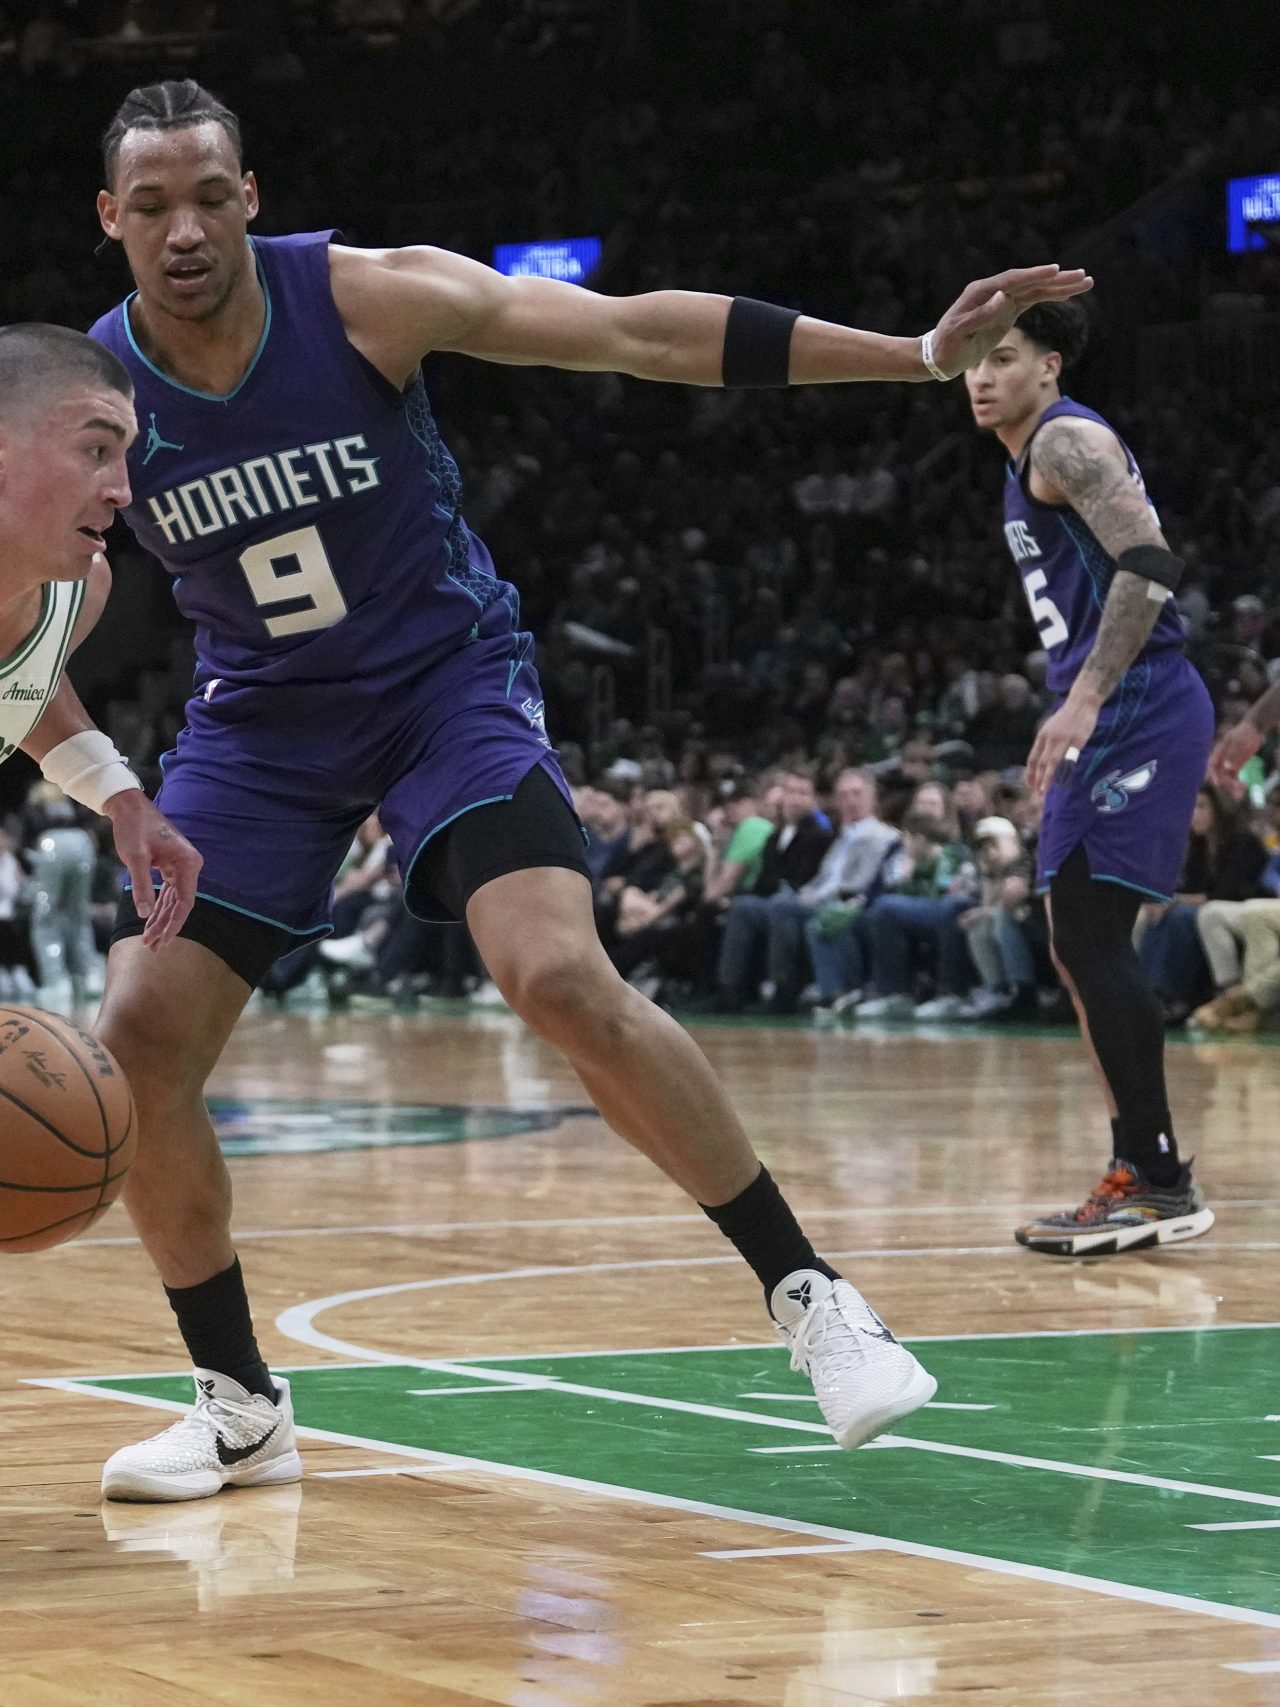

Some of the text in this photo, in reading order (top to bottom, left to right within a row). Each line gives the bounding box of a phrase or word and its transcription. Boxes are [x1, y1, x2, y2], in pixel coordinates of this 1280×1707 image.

[147, 433, 381, 544] HORNETS
[237, 522, 348, 640] 9
[2, 681, 45, 701] Amica
